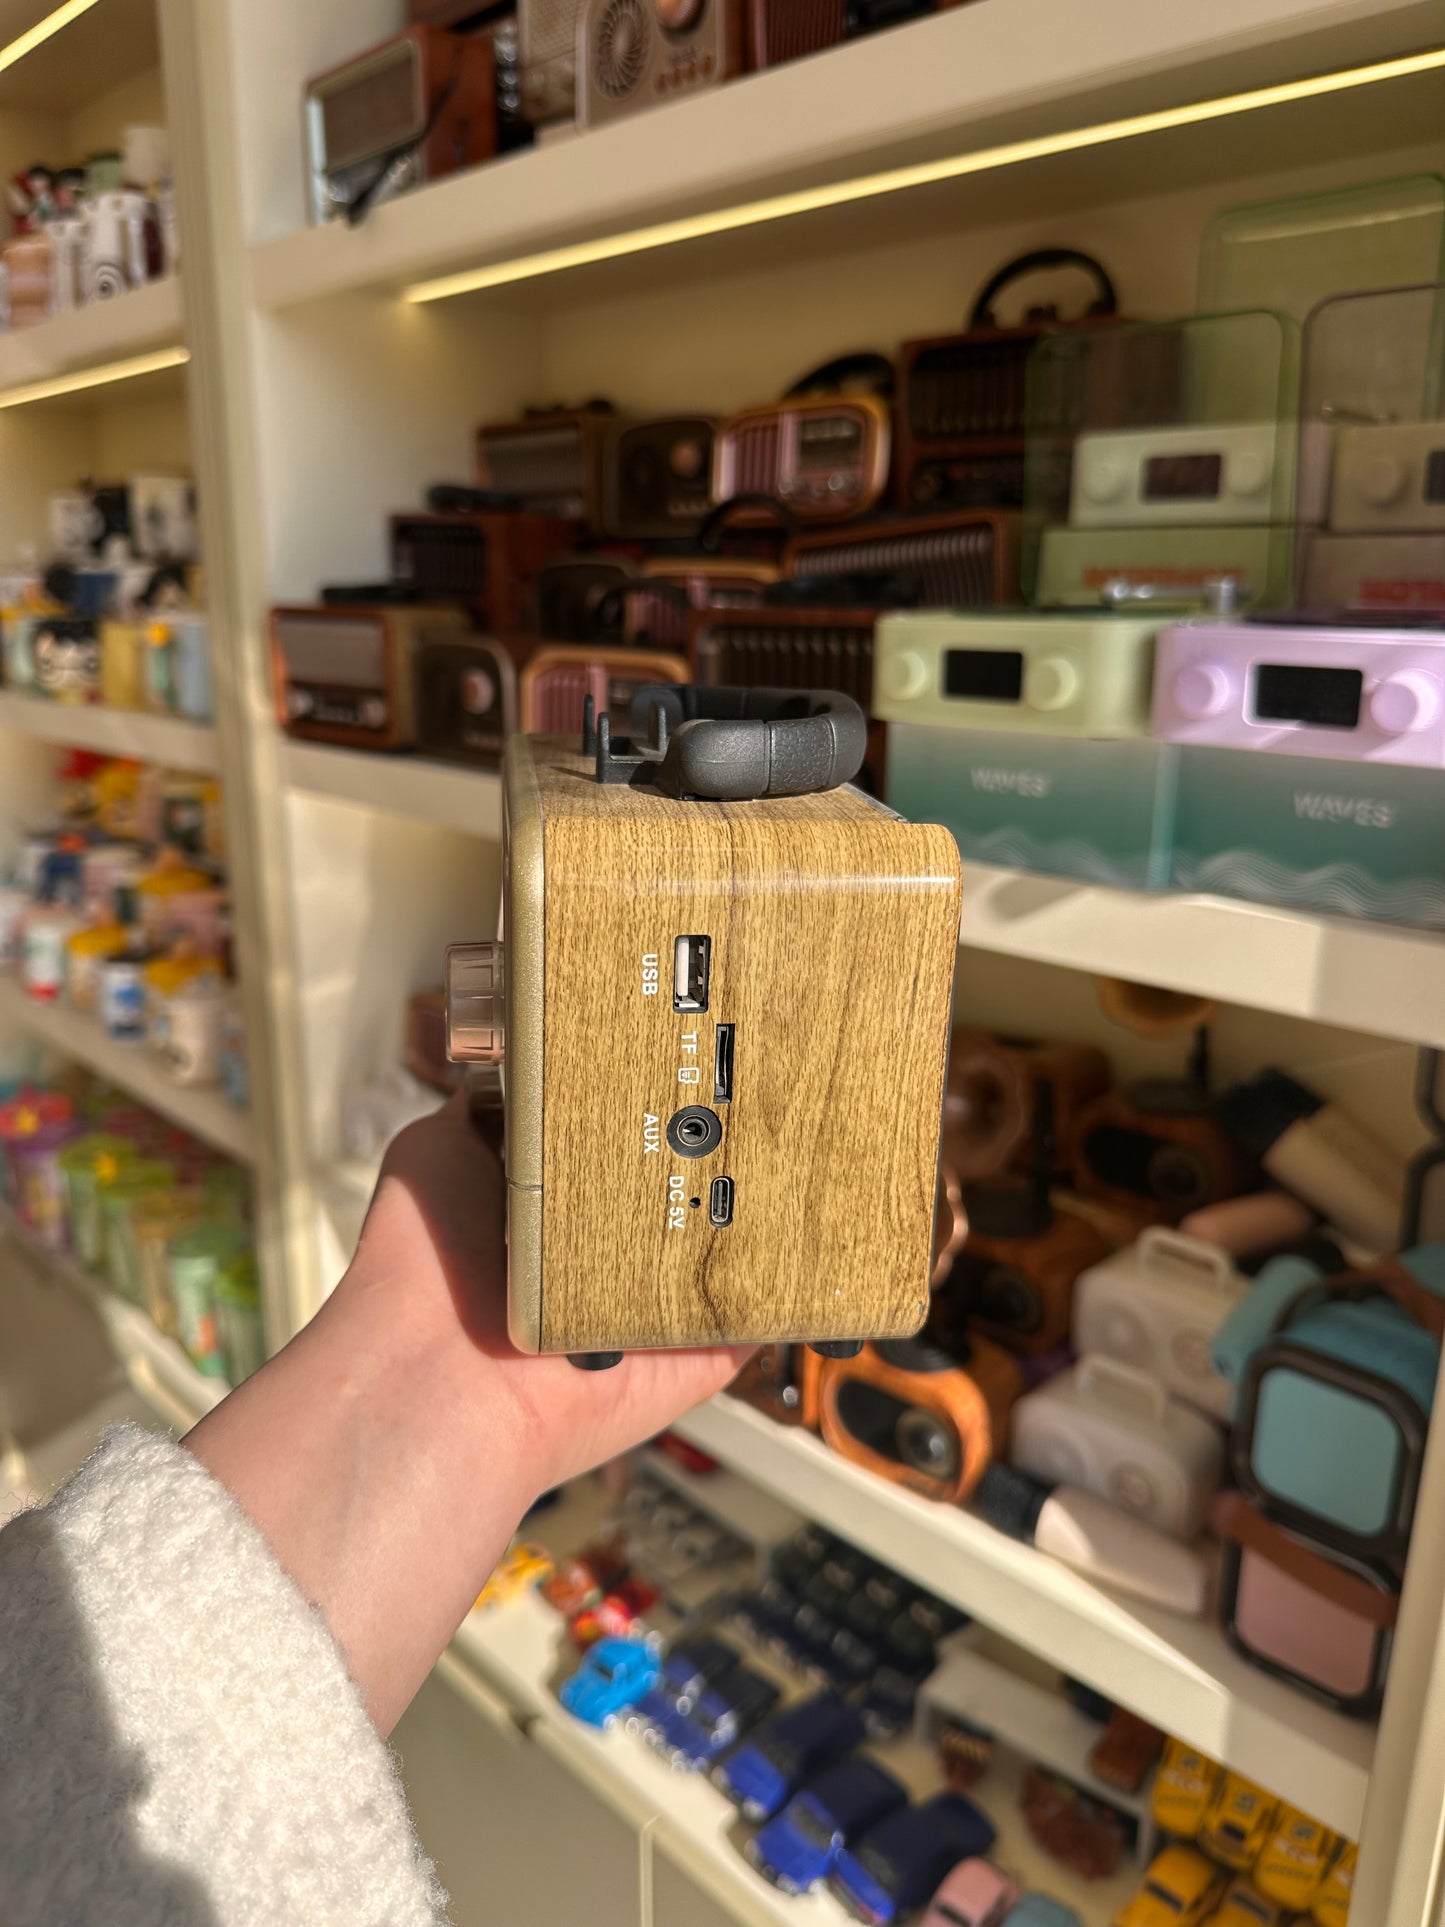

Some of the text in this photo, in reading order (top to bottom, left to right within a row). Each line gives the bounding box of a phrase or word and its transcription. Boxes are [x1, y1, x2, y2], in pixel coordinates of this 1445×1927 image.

[972, 768, 1048, 798] WAVES
[1294, 793, 1392, 828] WAVES
[642, 953, 658, 996] USB
[681, 1030, 697, 1055] TF
[643, 1112, 660, 1154] AUX
[669, 1175, 685, 1202] DC
